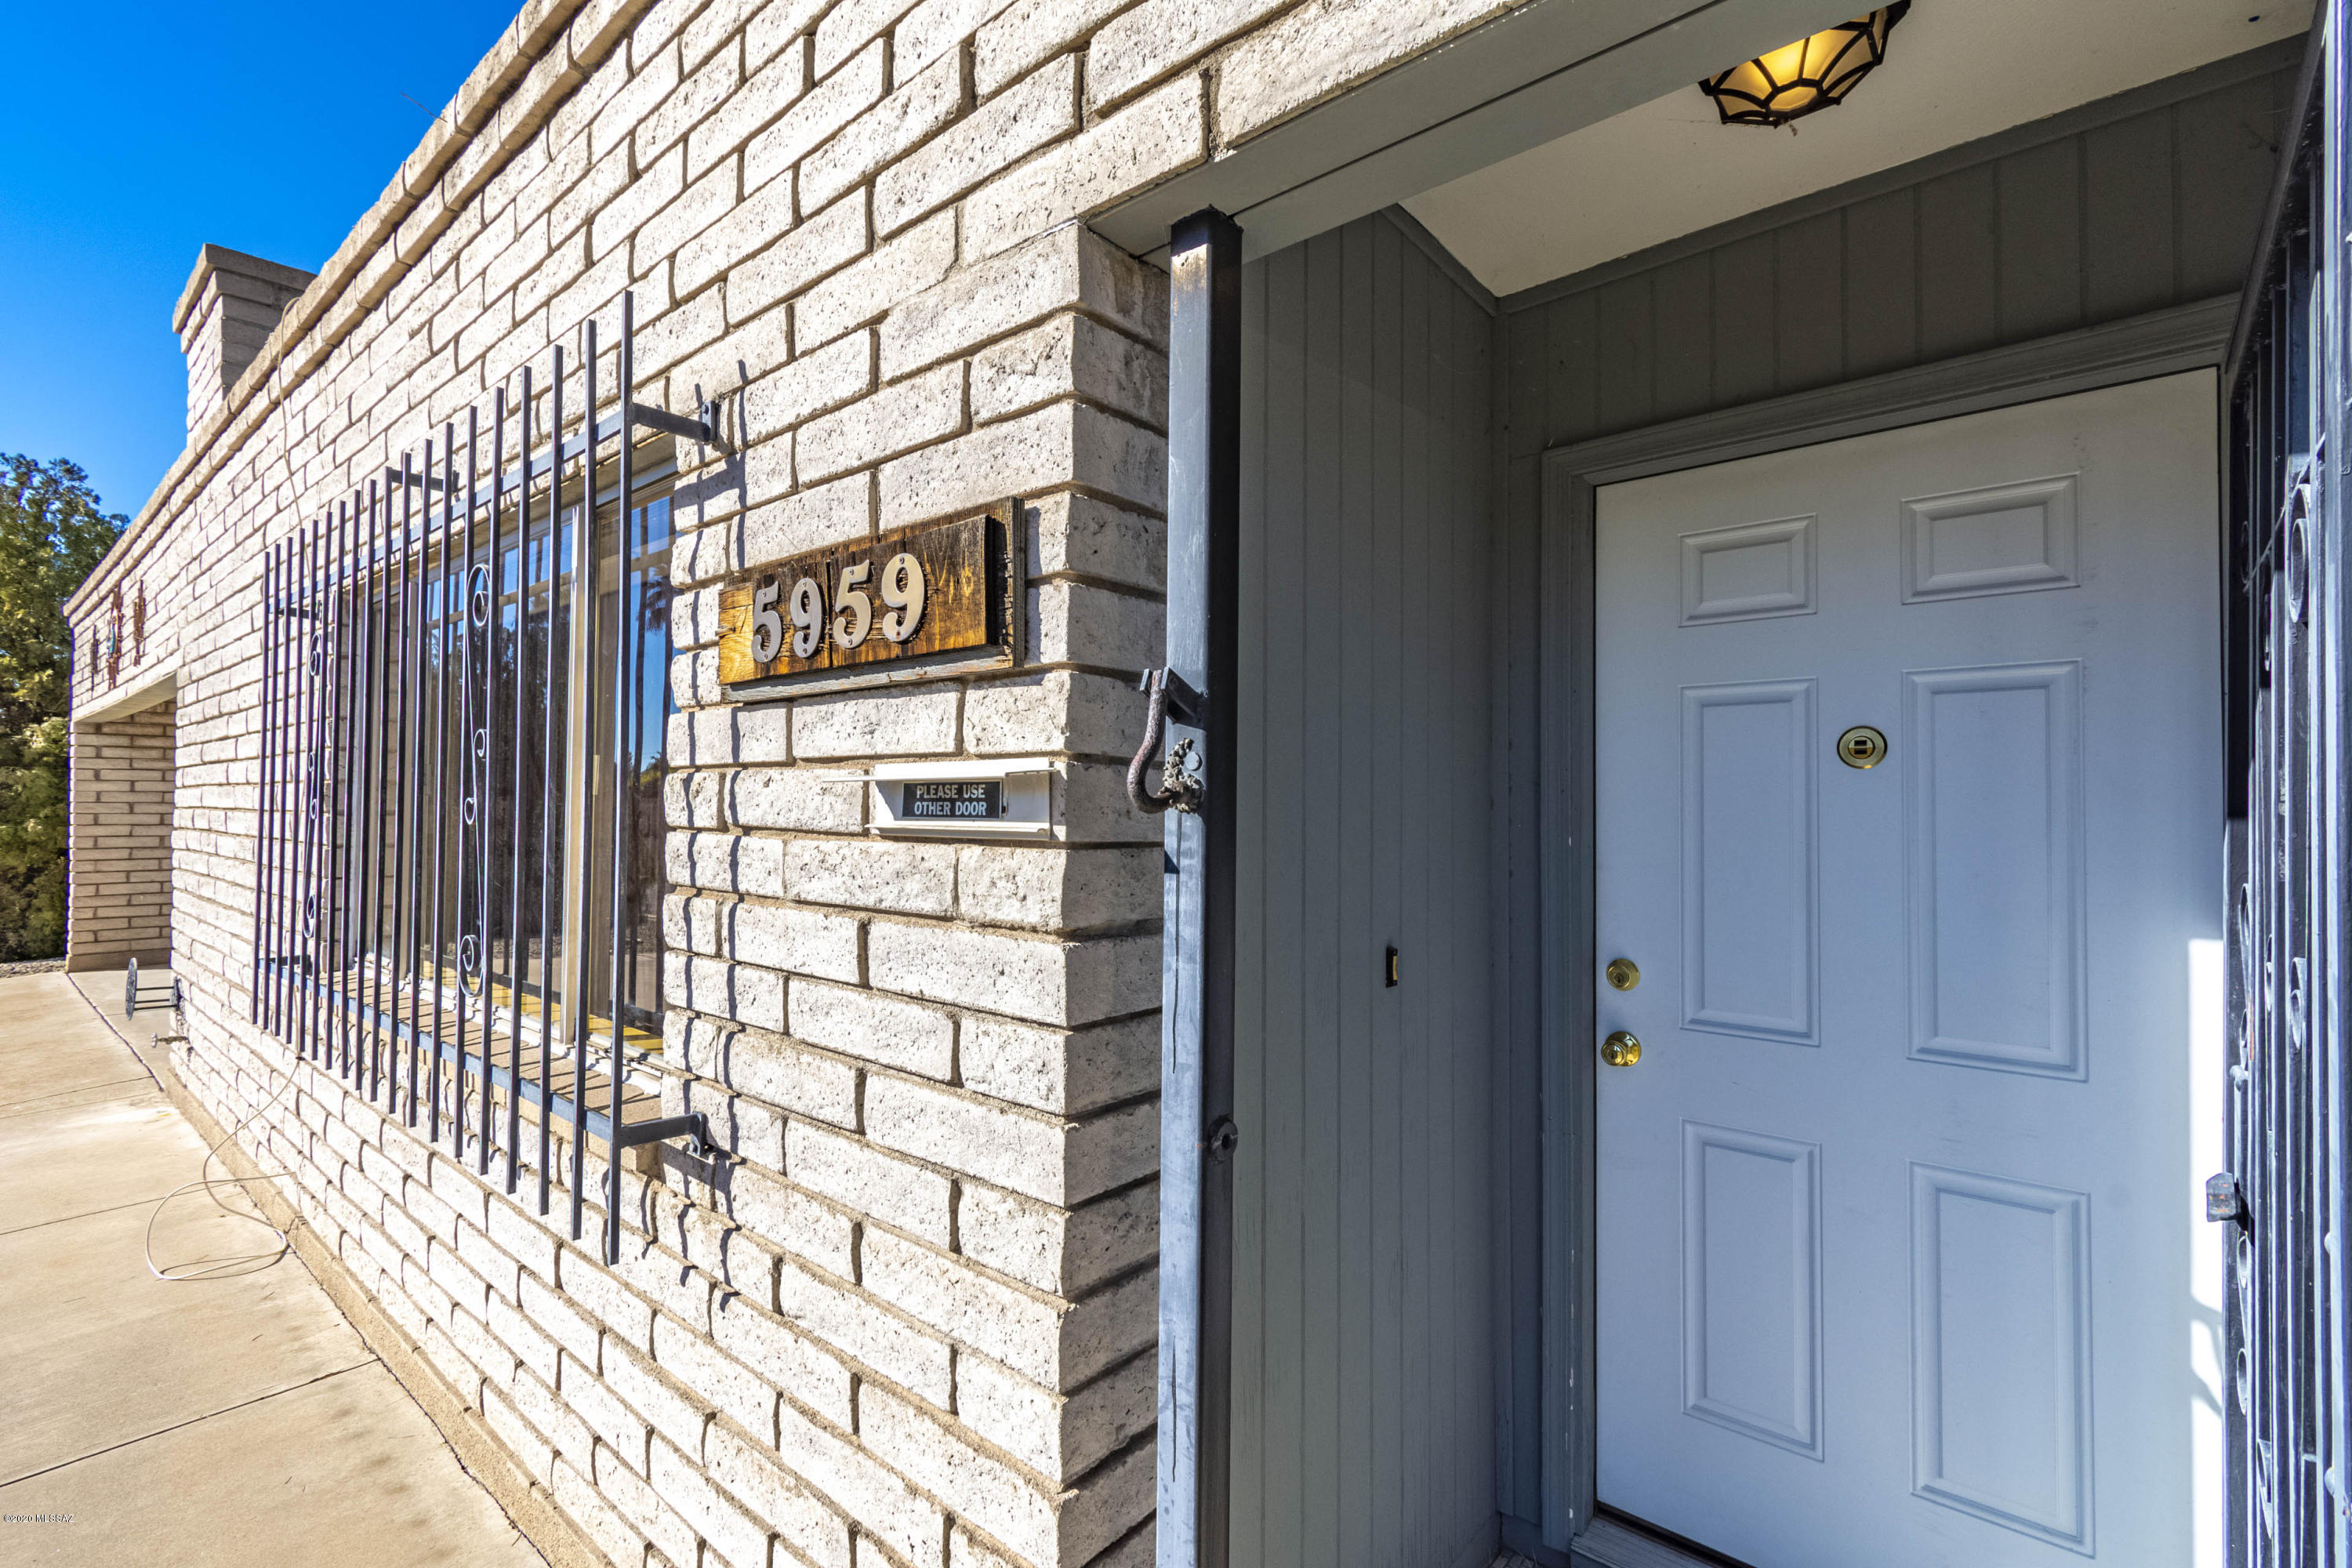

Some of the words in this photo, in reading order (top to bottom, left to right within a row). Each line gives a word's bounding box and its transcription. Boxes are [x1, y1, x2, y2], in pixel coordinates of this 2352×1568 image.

[751, 553, 926, 663] 5959
[916, 784, 959, 799] PLEASE
[963, 784, 985, 798] USE
[914, 801, 951, 815] OTHER
[955, 801, 987, 816] DOOR
